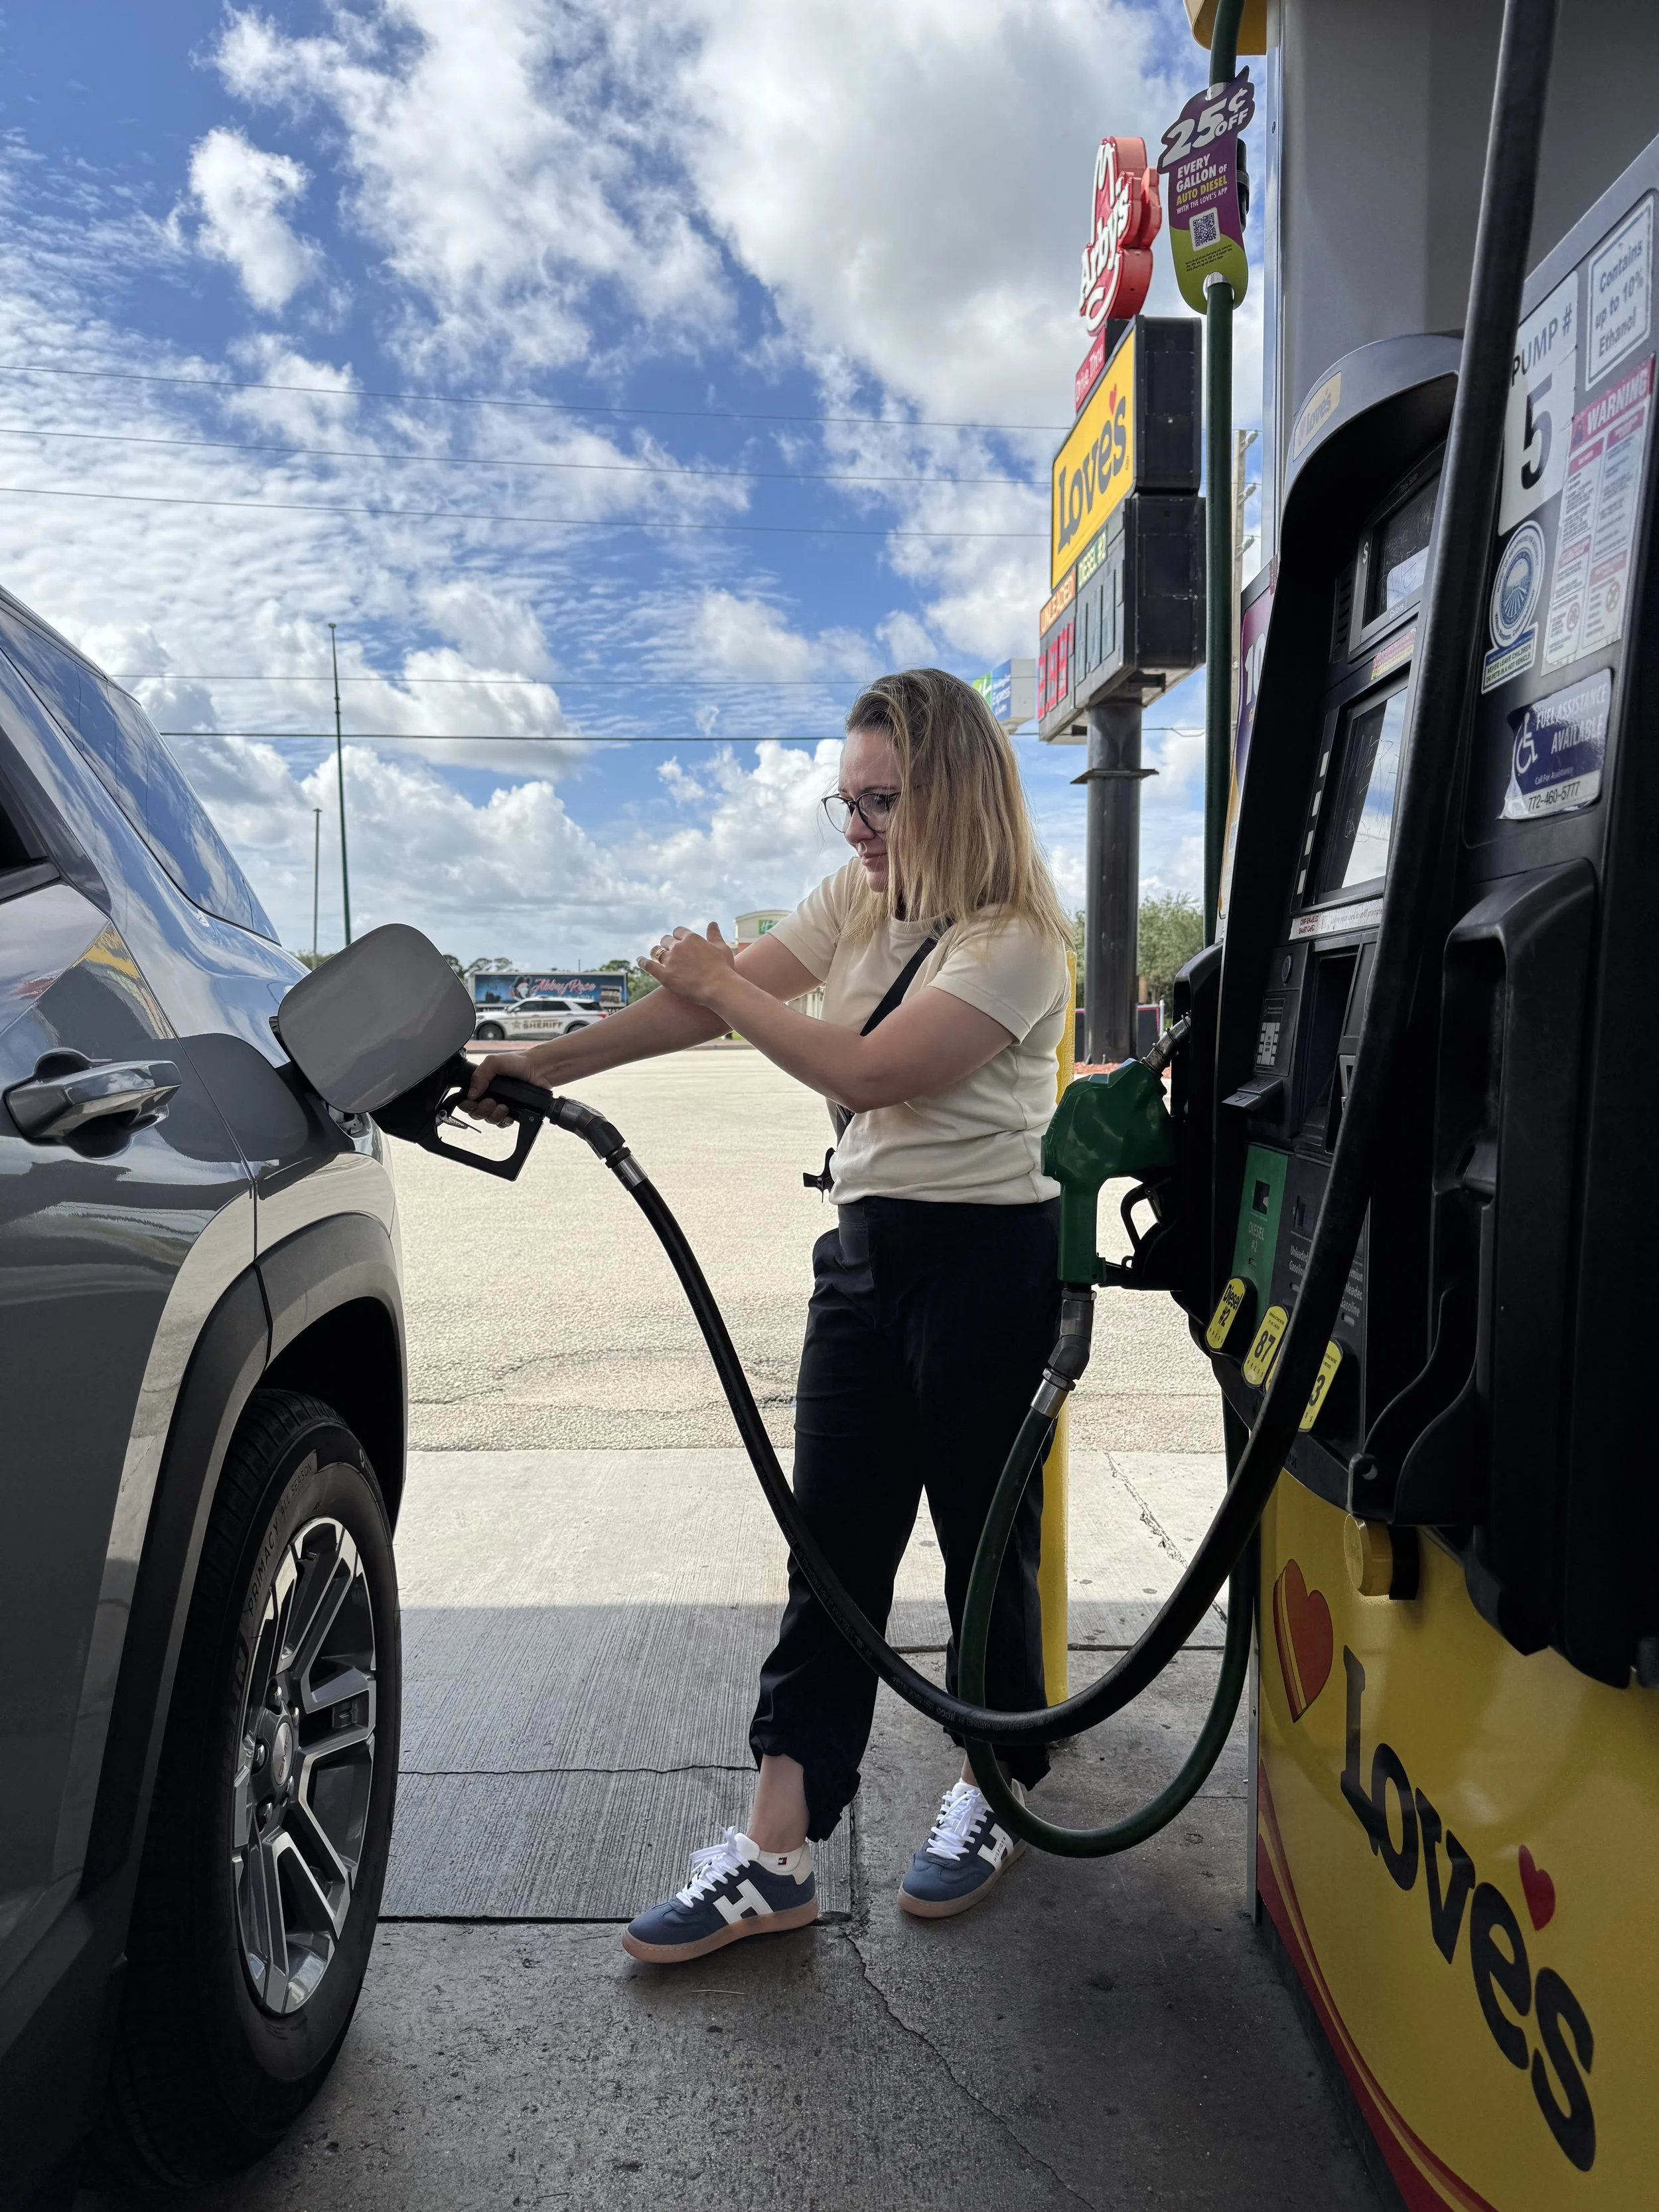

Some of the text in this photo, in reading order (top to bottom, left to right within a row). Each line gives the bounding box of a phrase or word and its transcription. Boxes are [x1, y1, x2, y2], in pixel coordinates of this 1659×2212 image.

[1162, 88, 1248, 168] 25¢
[1214, 108, 1249, 137] OFF
[1176, 163, 1228, 193] GALLON OF
[1177, 153, 1210, 180] EVERY
[1176, 175, 1228, 206] AUTO DIESEL
[1176, 186, 1228, 214] WITH THE LOVE'S APP
[1600, 240, 1642, 293] Contains
[1595, 307, 1607, 330] up
[1610, 295, 1619, 316] to
[1512, 302, 1572, 387] PUMP #
[1599, 305, 1636, 357] Ethanol
[1588, 366, 1648, 435] WARNING
[1521, 372, 1553, 490] 5
[1536, 683, 1607, 731] FUEL ASSISTANCE
[1551, 713, 1605, 754] AVAILABLE
[1528, 780, 1581, 810] 772-460-5777
[1248, 1220, 1265, 1241] DIESEL
[1251, 1240, 1259, 1253] #2
[1223, 1284, 1244, 1311] Diesel
[1218, 1305, 1231, 1327] #2
[1254, 1330, 1276, 1363] 87
[1309, 1374, 1326, 1406] 3
[243, 1461, 313, 1616] PRIMACY ALL SEASON
[993, 1836, 1007, 1862] HILFIGER
